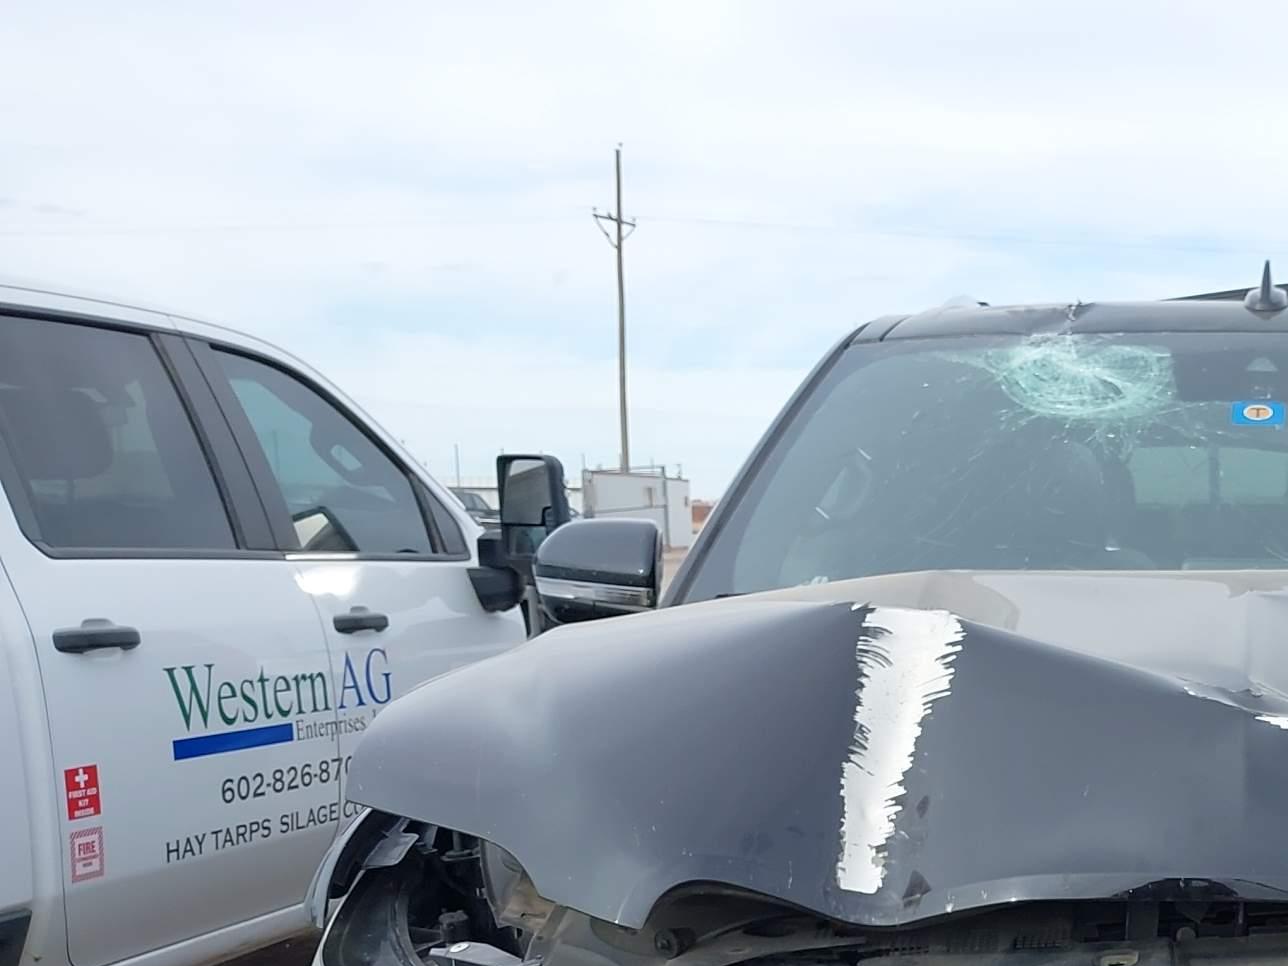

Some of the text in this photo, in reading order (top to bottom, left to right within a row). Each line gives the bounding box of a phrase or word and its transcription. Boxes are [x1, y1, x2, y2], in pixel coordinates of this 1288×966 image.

[162, 648, 392, 732] Western AG
[296, 713, 368, 742] Enterprises
[78, 840, 97, 856] FIRE
[166, 833, 207, 863] HAY
[211, 818, 272, 850] TARPS
[279, 802, 339, 834] SILAGE
